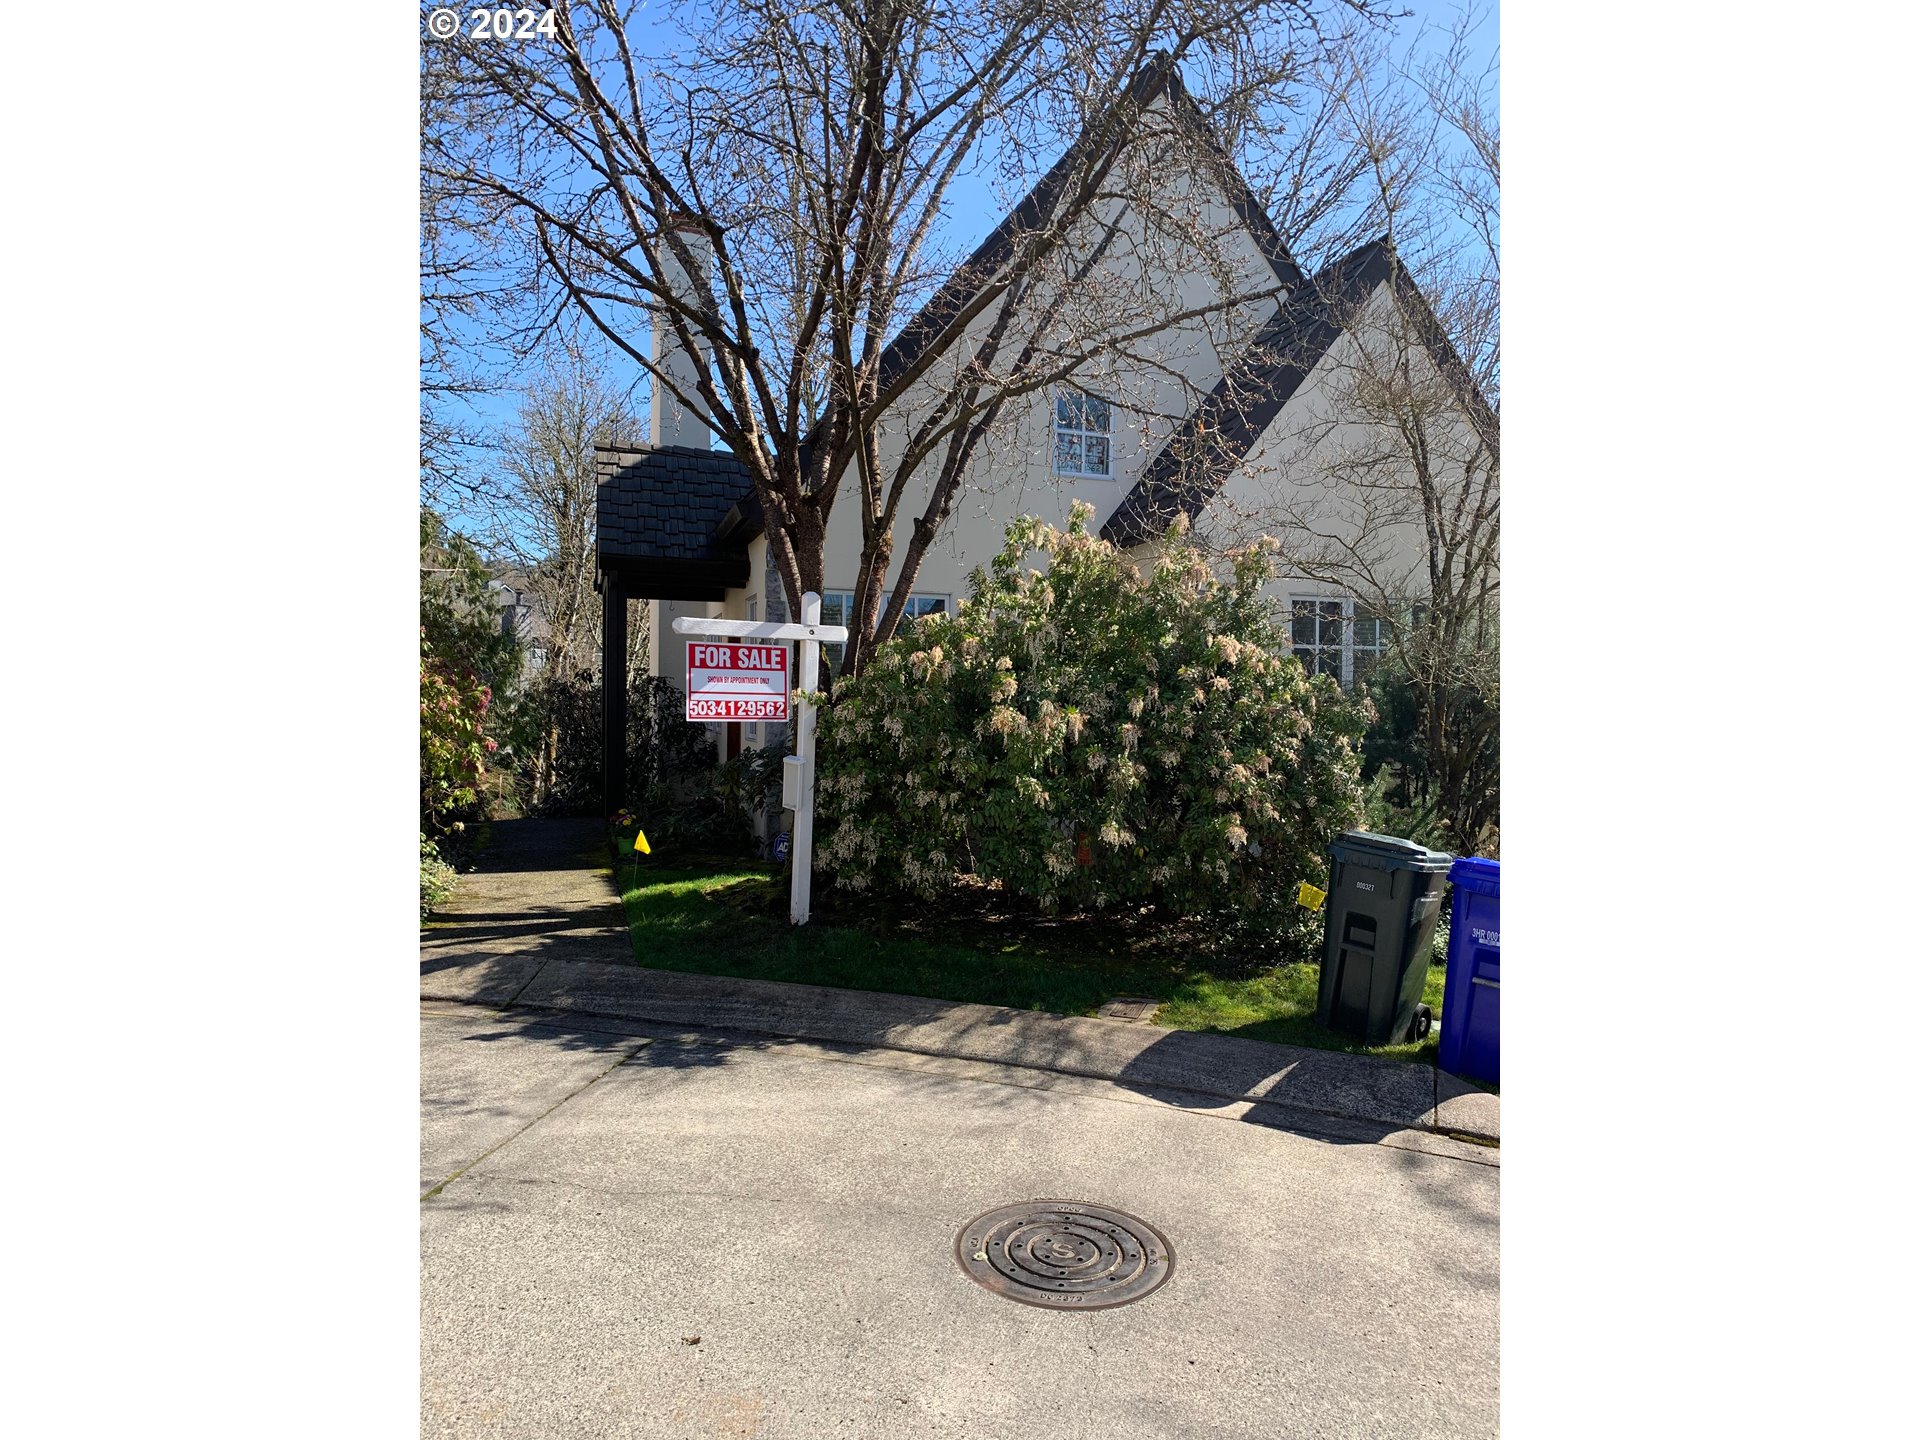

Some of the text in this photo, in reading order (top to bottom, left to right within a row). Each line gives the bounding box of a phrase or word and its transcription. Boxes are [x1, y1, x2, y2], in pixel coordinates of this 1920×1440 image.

[694, 646, 782, 669] FOR SALE
[707, 675, 723, 684] SHOWN
[730, 676, 759, 685] APPOINTMENT
[759, 677, 770, 685] ONLY
[776, 841, 788, 853] AD
[1051, 1242, 1076, 1259] S
